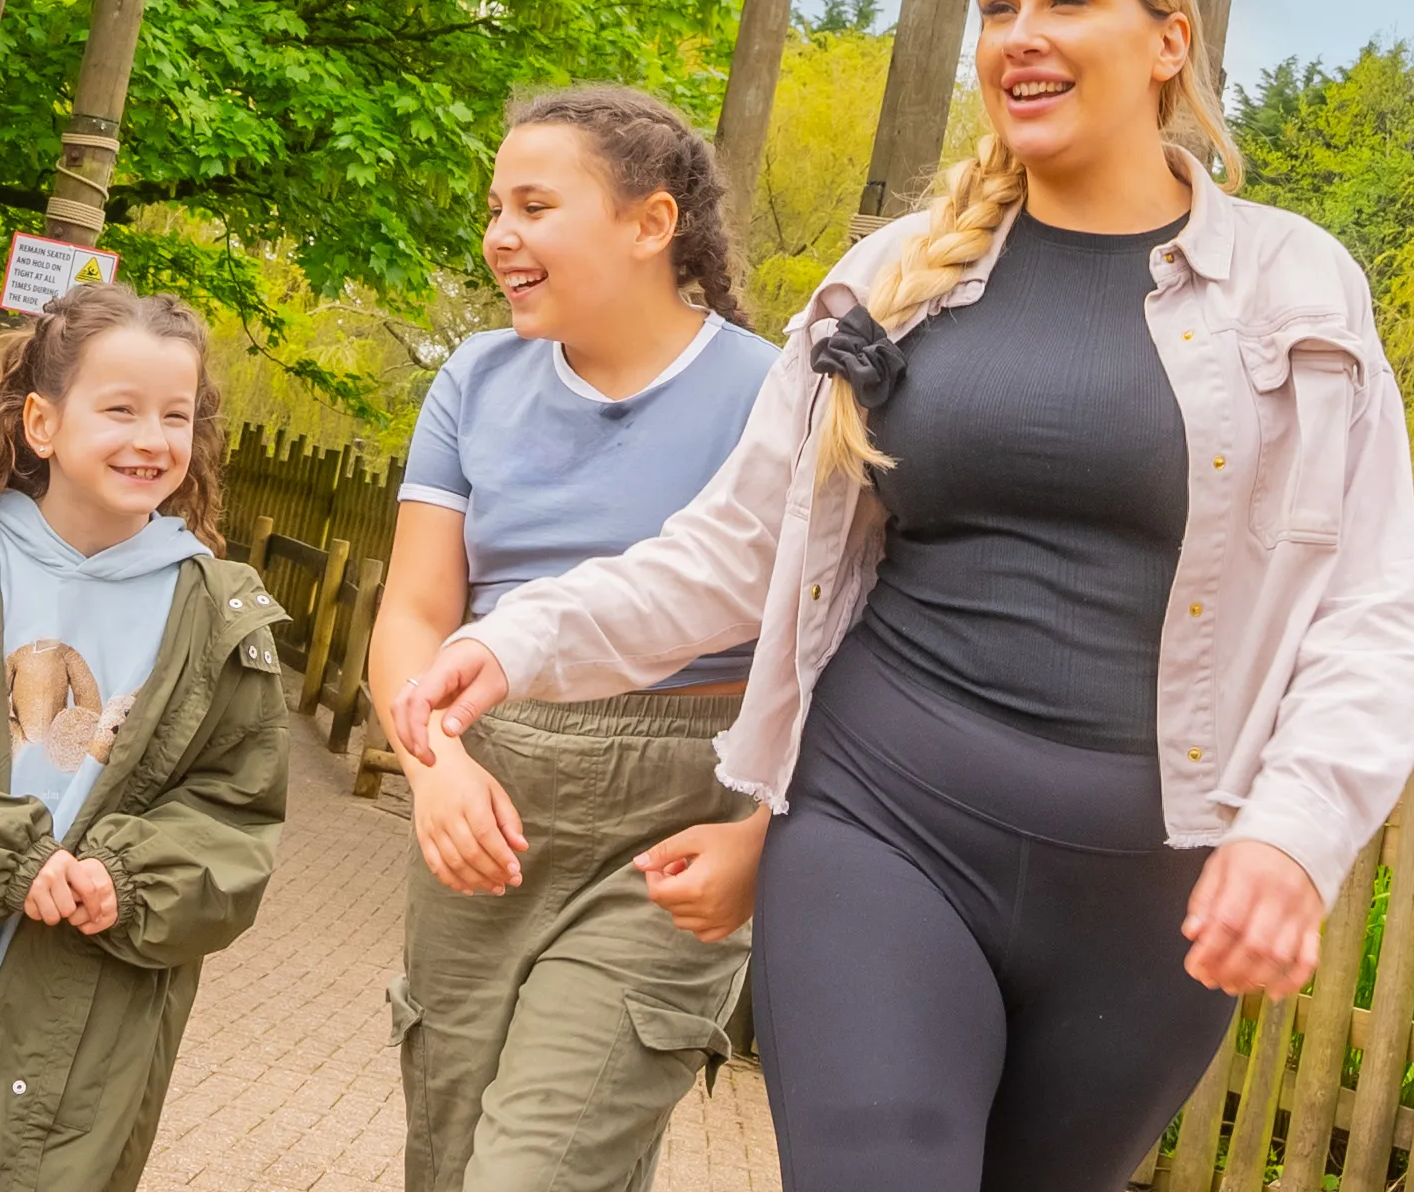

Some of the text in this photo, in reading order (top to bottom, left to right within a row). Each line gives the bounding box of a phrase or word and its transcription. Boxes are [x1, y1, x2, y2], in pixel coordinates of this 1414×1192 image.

[18, 243, 72, 261] REMAIN SEATED
[16, 256, 62, 272] AND HOLD ON
[14, 268, 56, 284] TIGHT AT ALL
[11, 280, 59, 296] TIMES DURING
[9, 292, 39, 306] THE RIDE
